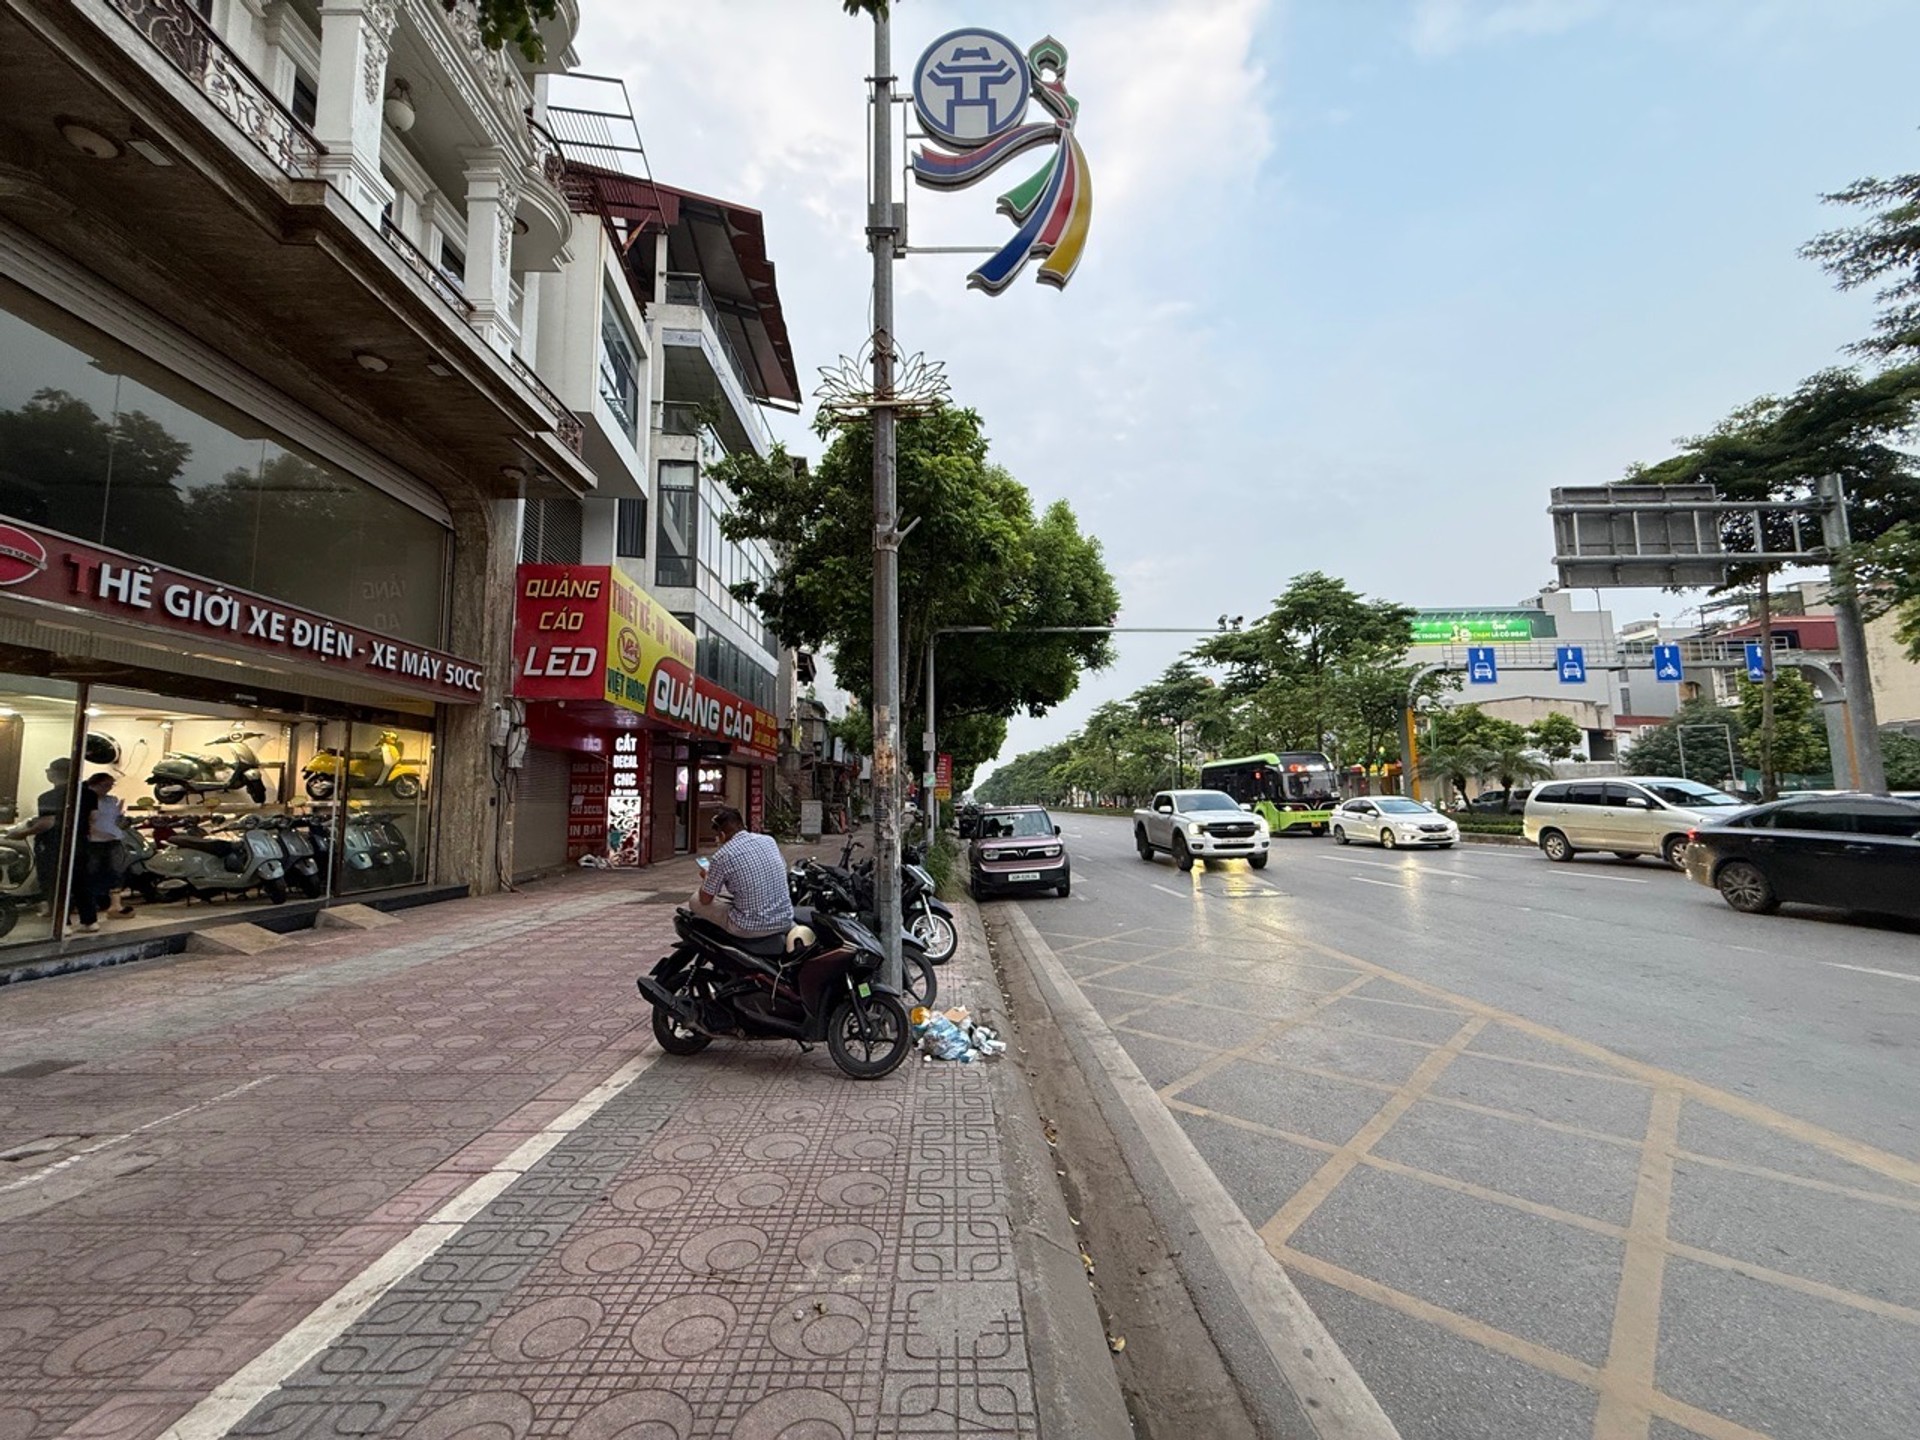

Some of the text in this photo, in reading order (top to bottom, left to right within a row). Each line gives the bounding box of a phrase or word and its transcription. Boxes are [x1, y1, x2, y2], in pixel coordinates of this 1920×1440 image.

[525, 573, 601, 599] QUẢNG
[68, 553, 158, 609] THẾ
[164, 586, 240, 630] GIỚI
[247, 605, 286, 642] XE
[292, 618, 353, 662] ĐIỆN
[370, 641, 397, 670] XE
[401, 651, 442, 680] MÁY
[445, 664, 482, 691] 50CC
[538, 606, 584, 630] CÁO
[523, 646, 599, 677] LED
[653, 669, 720, 732] QUẢNG
[722, 701, 753, 742] CÁO
[613, 773, 637, 787] CNC
